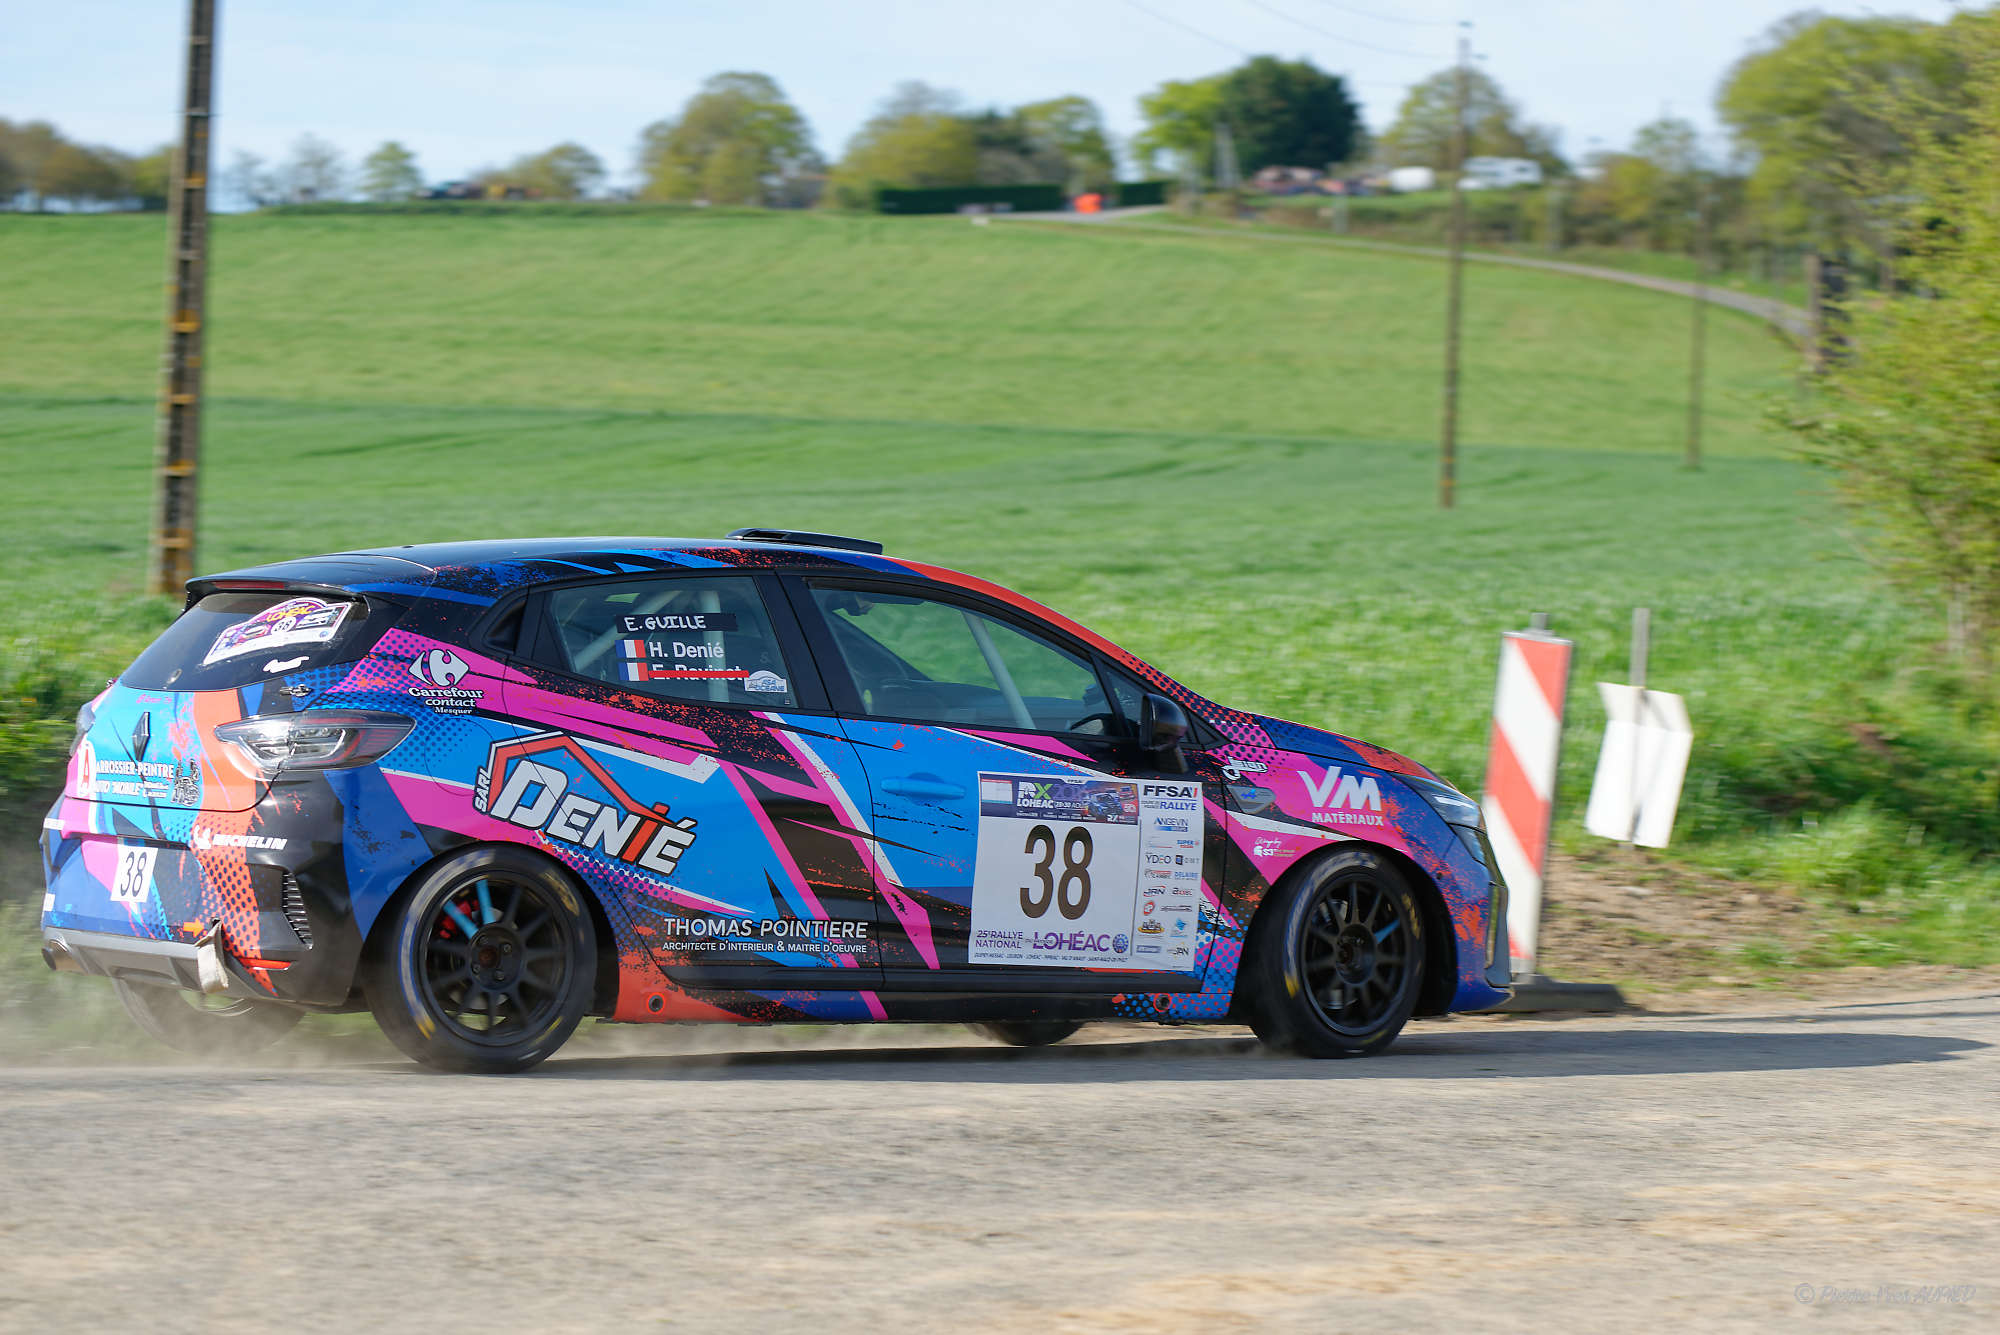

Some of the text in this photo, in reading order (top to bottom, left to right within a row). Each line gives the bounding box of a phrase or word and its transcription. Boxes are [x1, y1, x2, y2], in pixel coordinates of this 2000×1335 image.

[644, 615, 707, 630] GUILLE
[648, 641, 725, 658] H. Denié
[408, 686, 485, 699] Carrefour
[425, 698, 476, 708] contact
[434, 706, 473, 716] Mesquer
[473, 766, 492, 814] SARL
[1143, 784, 1193, 799] FFSA
[1296, 765, 1383, 812] VM
[1016, 798, 1054, 809] LOHEAC
[1159, 801, 1198, 811] RALLYE
[489, 757, 698, 876] DENIÉ
[1311, 811, 1385, 827] MATÉRIAUX
[211, 833, 288, 851] MICHELIN
[119, 850, 148, 898] 38
[1019, 823, 1094, 921] 38
[663, 917, 869, 939] THOMAS POINTIERE
[662, 940, 868, 953] ARCHITECTE D'INTERIEUR & MAITRE D'OEUVRE
[975, 939, 1022, 949] NATIONAL
[1032, 930, 1111, 952] LOHÉAC
